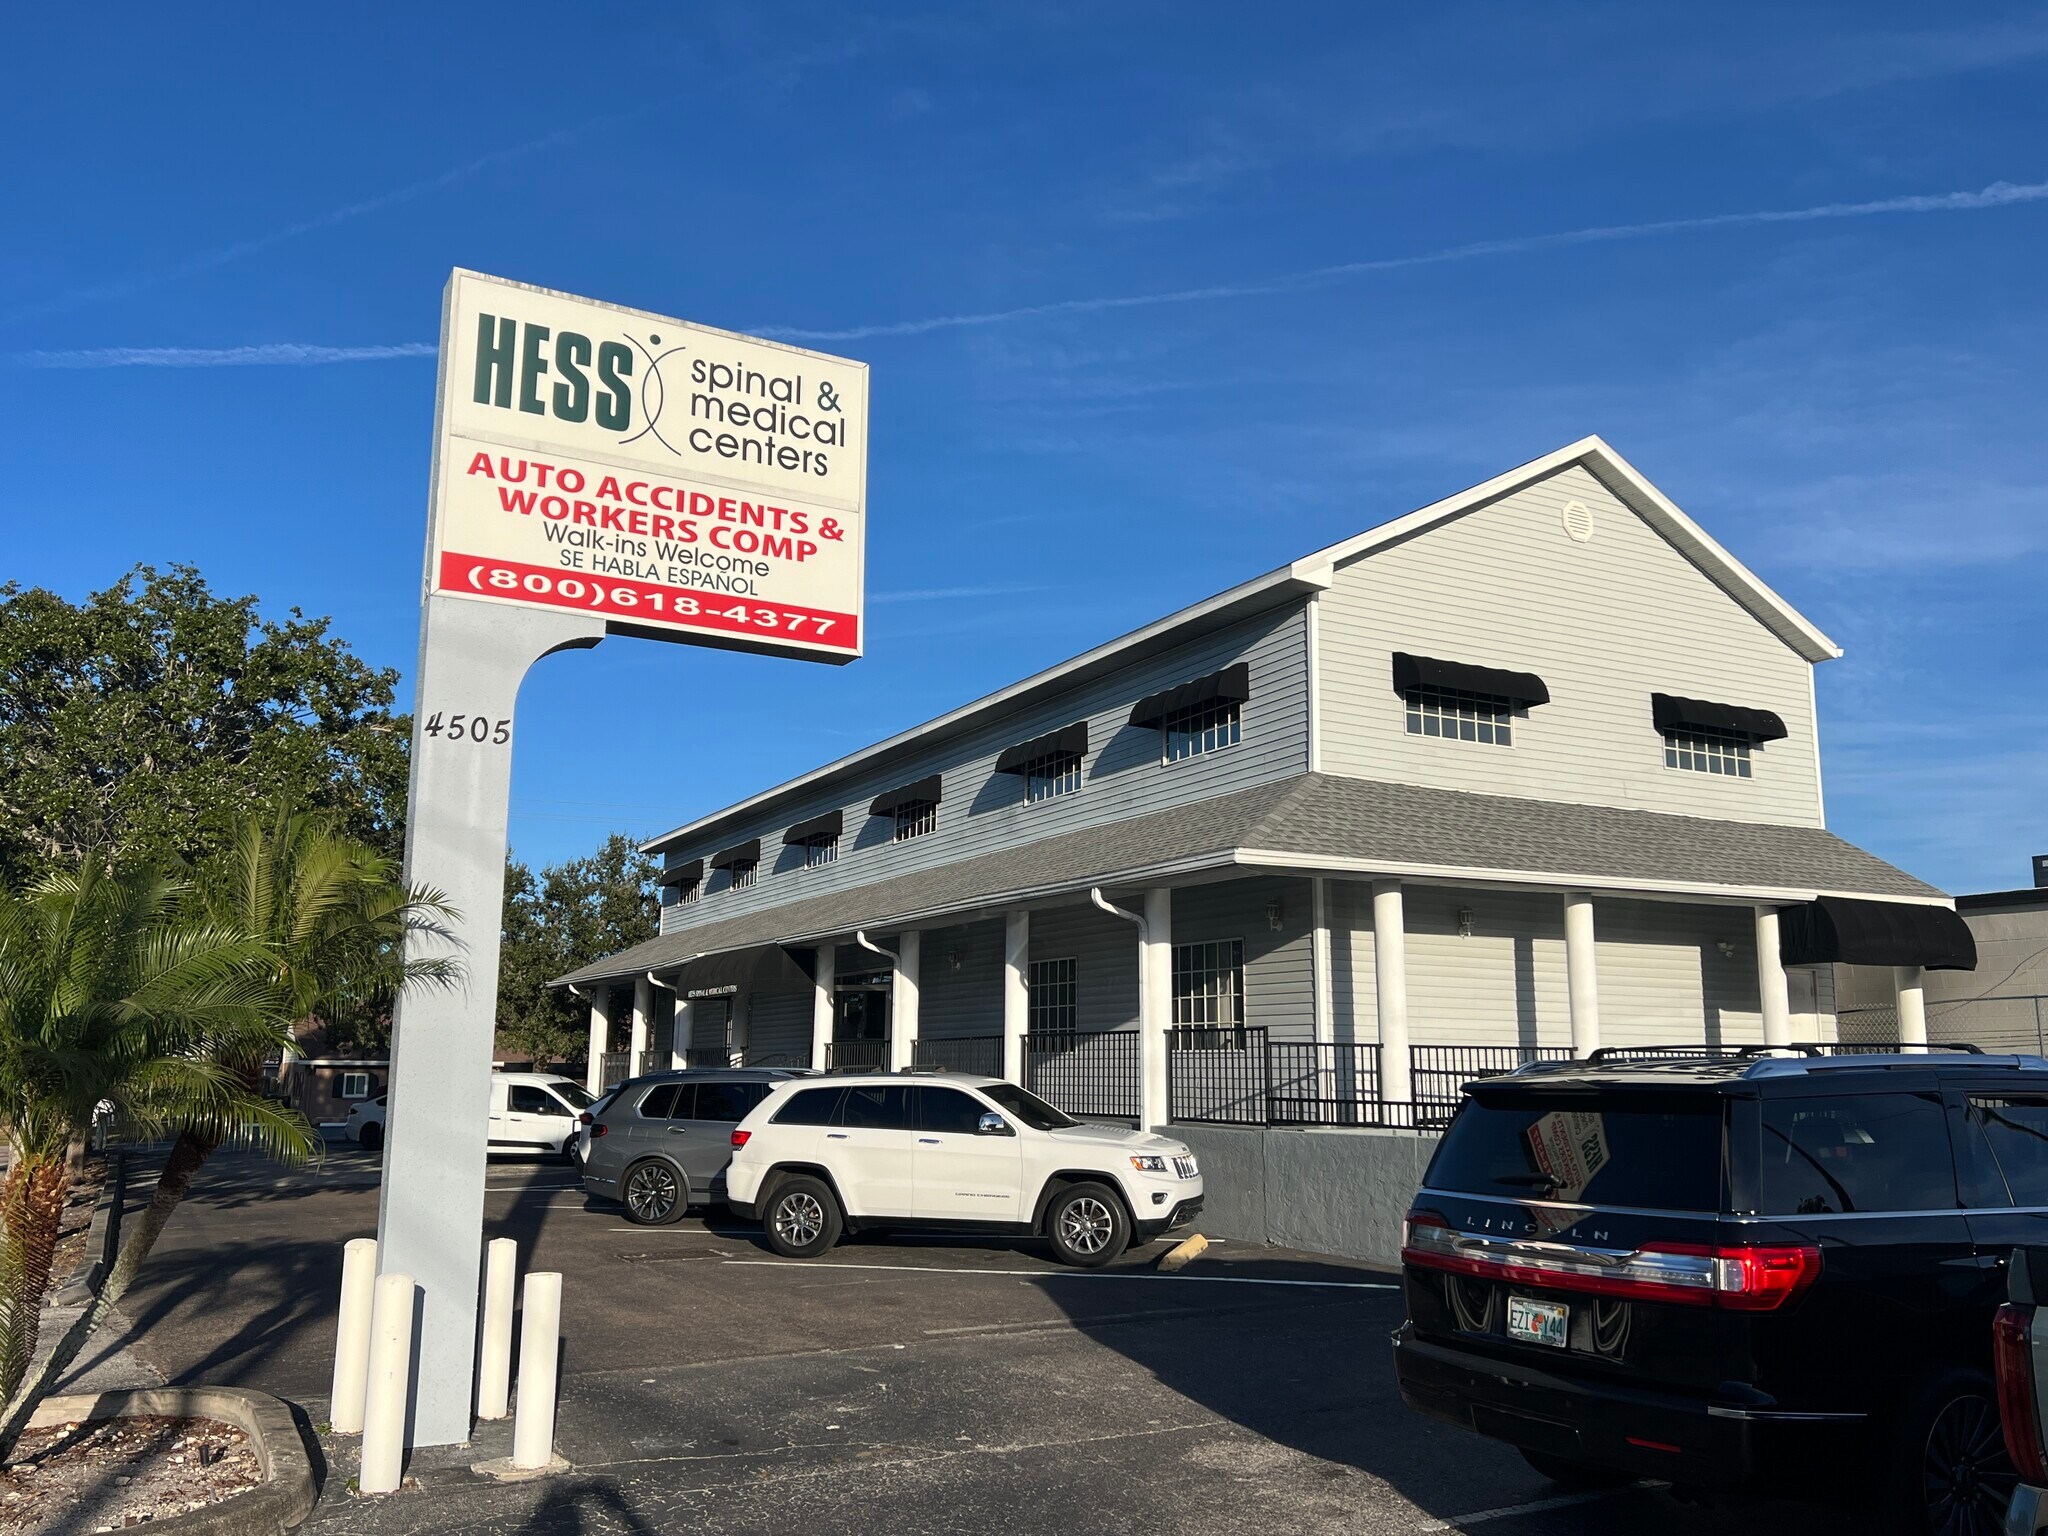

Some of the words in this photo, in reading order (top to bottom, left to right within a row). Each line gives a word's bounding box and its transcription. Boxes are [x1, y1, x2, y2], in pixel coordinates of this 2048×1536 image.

[473, 312, 634, 432] HESS
[691, 358, 802, 404] spinal
[817, 381, 842, 413] &
[691, 389, 846, 448] medical
[689, 427, 828, 477] centers
[467, 451, 585, 493] AUTO
[596, 476, 809, 534] ACCIDENTS
[819, 517, 845, 542] &
[498, 486, 699, 543] WORKERS
[709, 526, 818, 563] COMP
[543, 520, 648, 558] Walk-ins
[654, 540, 770, 577] Welcome
[560, 549, 584, 569] SE
[593, 554, 660, 581] HABLA
[668, 568, 758, 597] ESPAÑOL
[467, 565, 837, 636] (800)618-4377
[424, 711, 511, 745] 4505
[1466, 1216, 1609, 1241] LINCOLN
